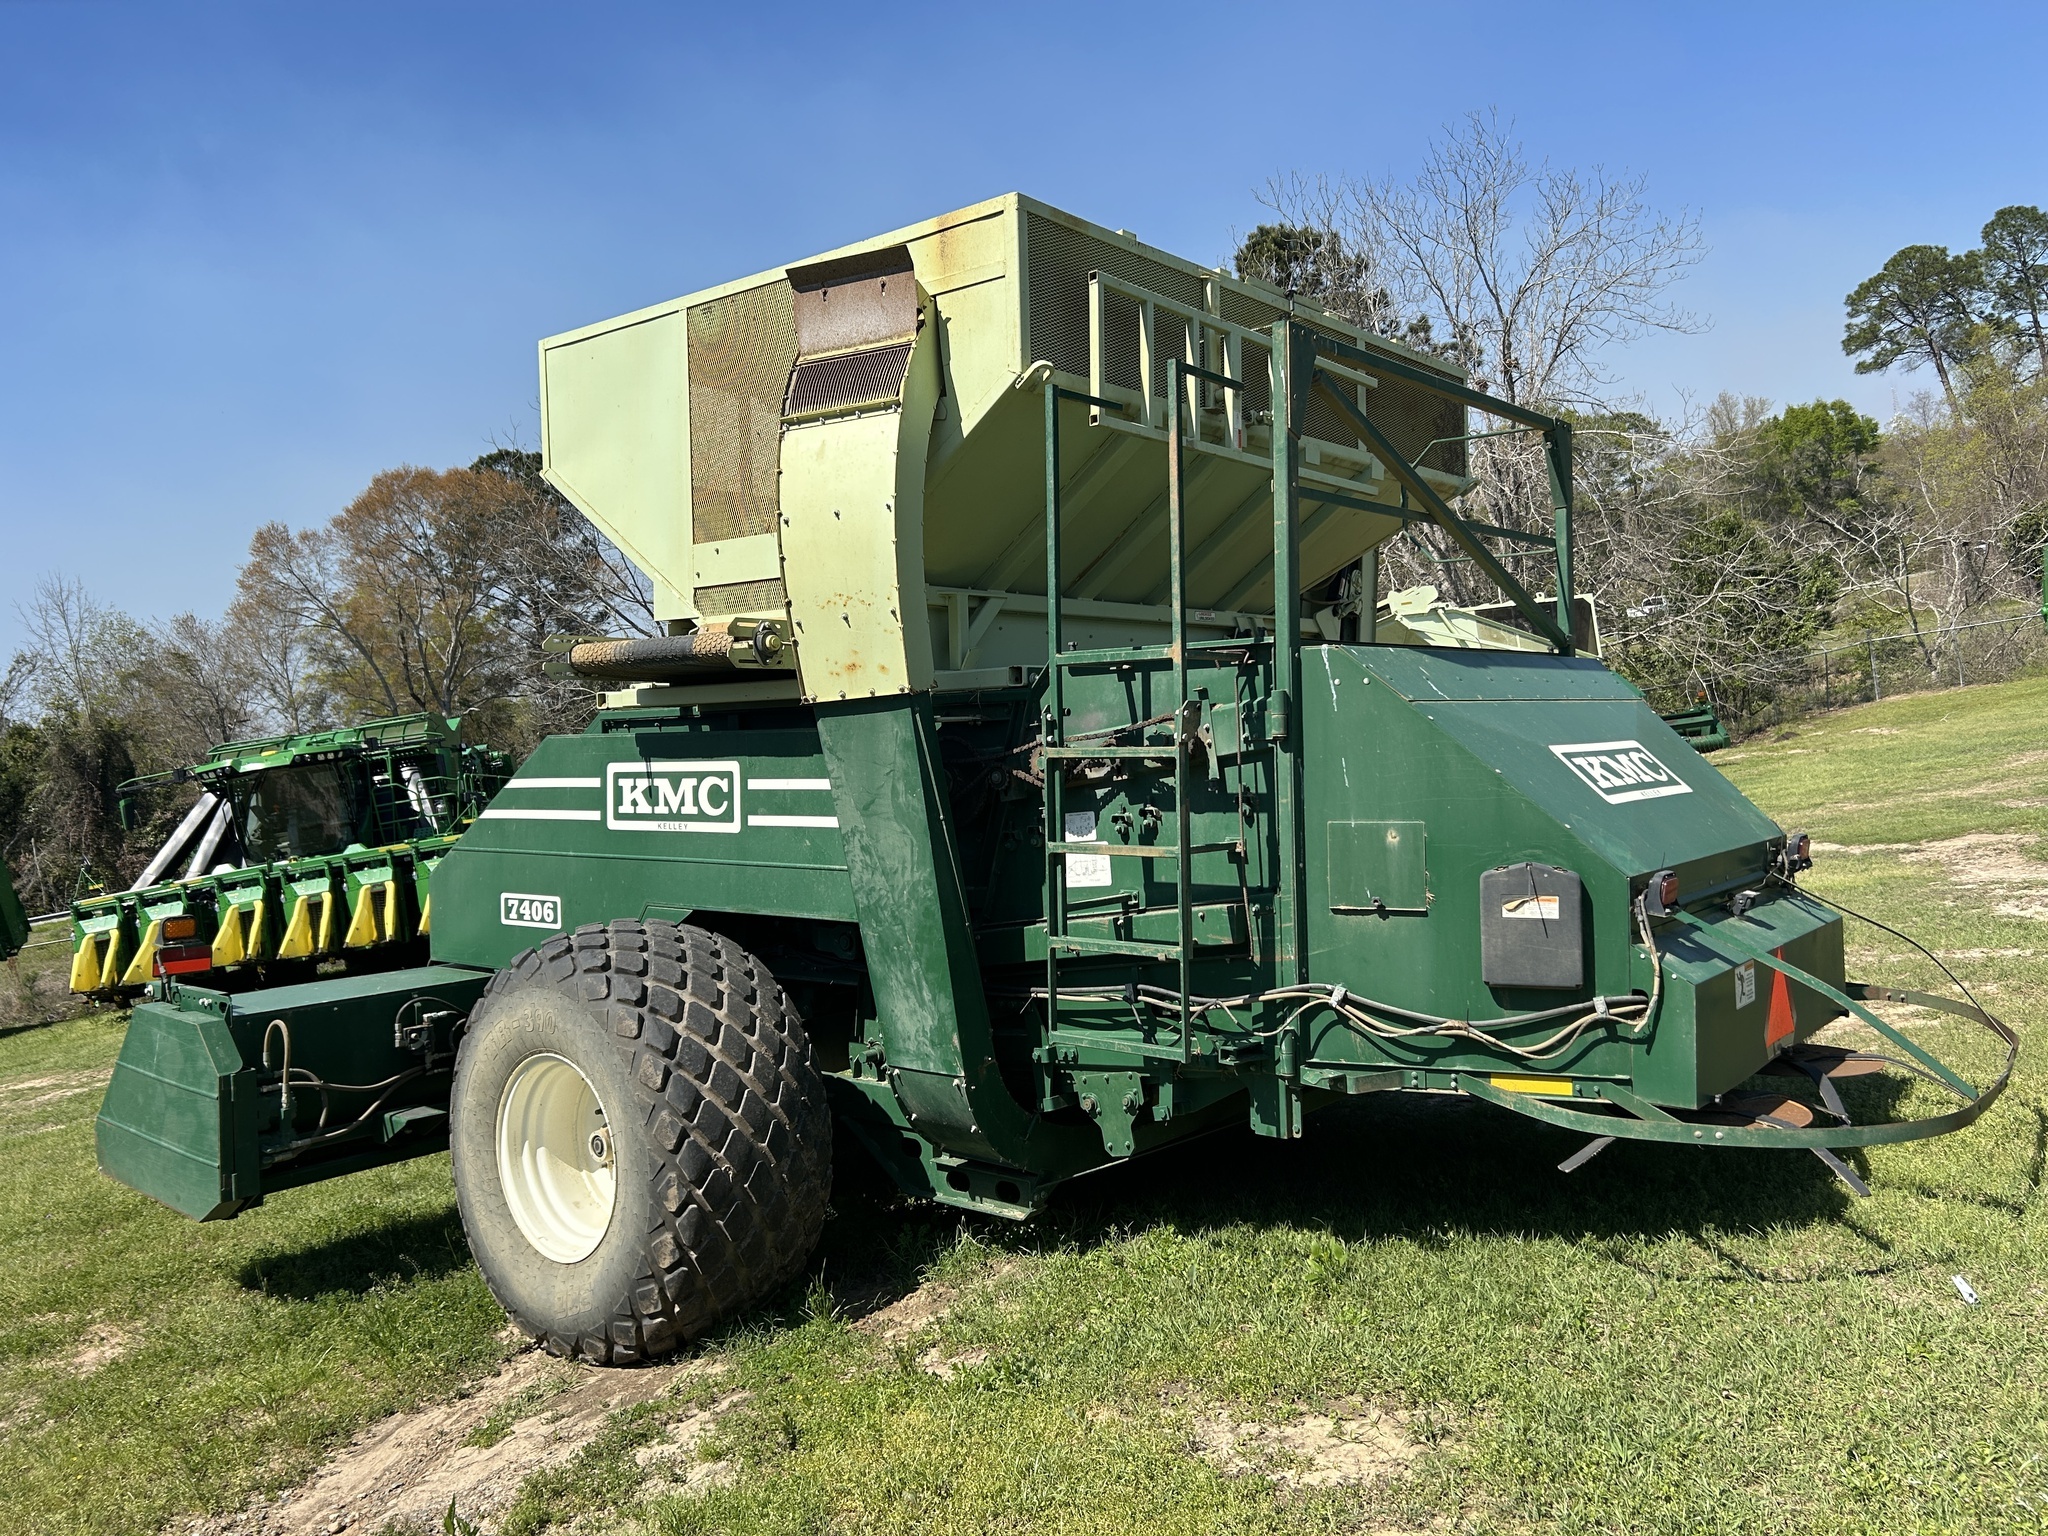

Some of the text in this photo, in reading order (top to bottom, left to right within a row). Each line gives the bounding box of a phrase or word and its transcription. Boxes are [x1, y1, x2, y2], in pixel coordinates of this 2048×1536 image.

[1570, 751, 1669, 789] KMC
[617, 775, 729, 817] KMC
[657, 822, 689, 831] KELLEY
[507, 898, 554, 924] 7406
